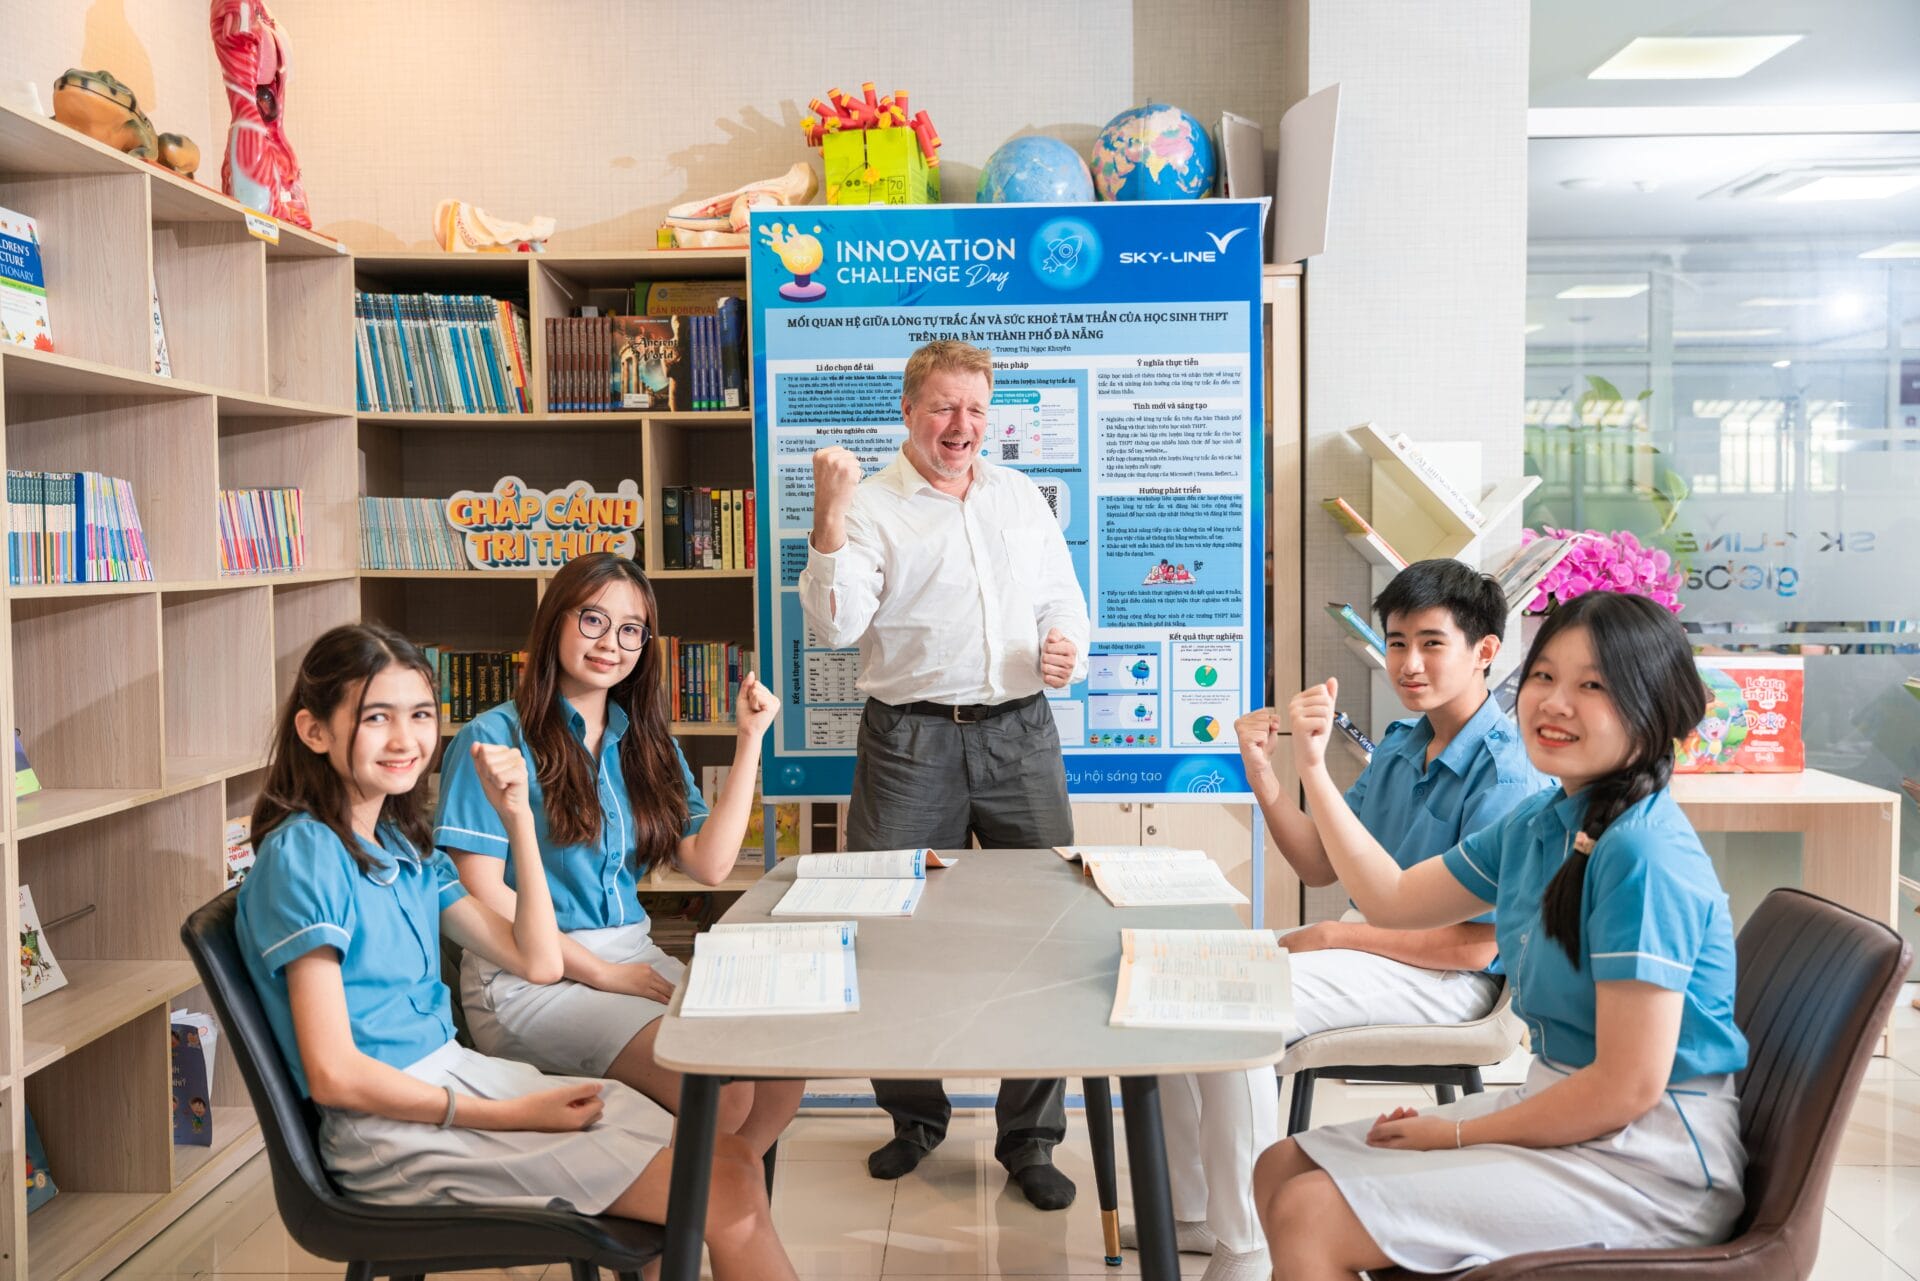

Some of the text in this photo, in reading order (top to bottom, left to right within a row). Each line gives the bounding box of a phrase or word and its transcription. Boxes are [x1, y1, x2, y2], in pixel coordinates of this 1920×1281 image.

[890, 181, 902, 190] 70
[890, 196, 904, 204] A4
[836, 238, 1016, 262] INNOVATION
[1120, 251, 1216, 263] SKY-LINE
[836, 264, 1010, 292] CHALLENGE Day
[811, 318, 843, 329] QUAN
[845, 316, 861, 328] HỆ
[862, 315, 890, 326] GIỮA
[892, 315, 922, 326] LÒNG
[923, 316, 938, 328] TỰ
[987, 314, 1002, 325] VÀ
[1004, 314, 1025, 324] SỨC
[1060, 313, 1084, 323] TÂM
[1119, 312, 1142, 322] CỦA
[1144, 313, 1168, 324] HỌC
[1170, 313, 1197, 321] SINH
[1199, 312, 1228, 321] THPT
[962, 330, 984, 340] BÀN
[986, 330, 1026, 340] THÀNH
[1028, 328, 1052, 340] PHỐ
[1054, 329, 1070, 339] ĐÀ
[450, 481, 638, 530] CHẮP CÁNH
[470, 532, 530, 565] TRI
[1084, 770, 1104, 784] hội
[1107, 771, 1138, 784] sáng
[1141, 772, 1162, 783] tạo
